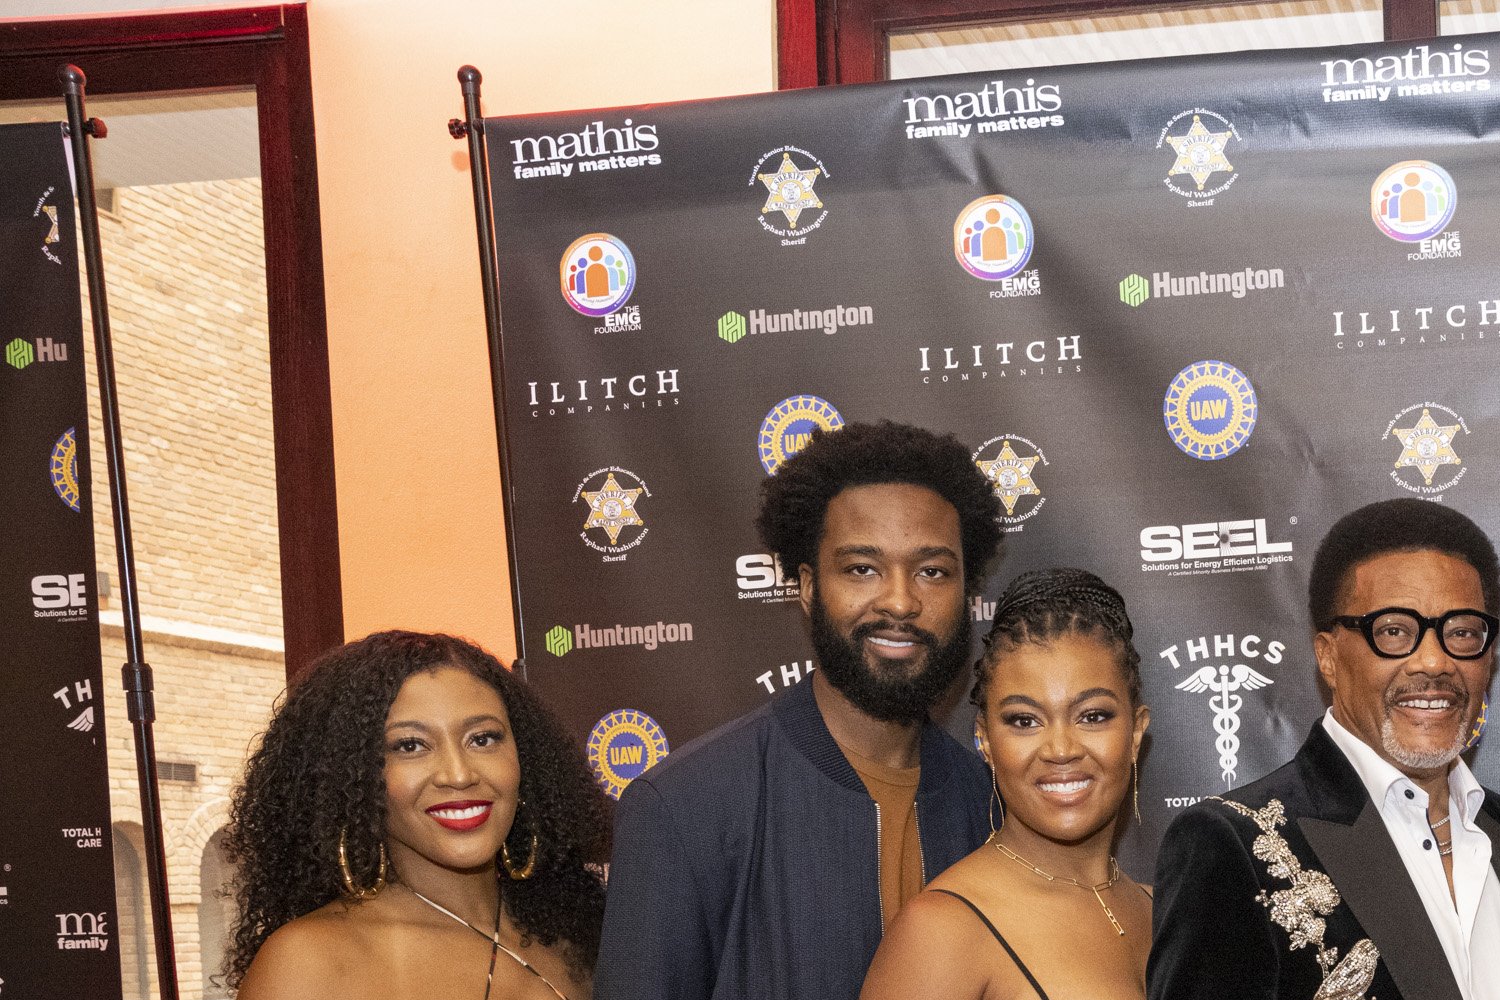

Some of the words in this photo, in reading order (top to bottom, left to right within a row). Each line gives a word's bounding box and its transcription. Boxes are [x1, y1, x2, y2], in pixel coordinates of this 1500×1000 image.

[1320, 44, 1490, 88] mathis
[1322, 83, 1392, 103] family
[1397, 78, 1490, 98] matters
[903, 79, 1062, 124] mathis
[906, 118, 972, 139] family
[978, 113, 1064, 134] matters
[510, 118, 659, 165] mathis
[513, 162, 573, 179] family
[579, 154, 661, 173] matters
[749, 164, 760, 186] Youth
[763, 146, 783, 159] Senior
[784, 146, 817, 161] Education
[817, 160, 830, 178] Fund
[1164, 178, 1192, 197] Raphael
[1194, 173, 1239, 198] Washington
[1187, 199, 1214, 207] Sheriff
[758, 215, 785, 236] Raphael
[787, 210, 828, 236] Washington
[781, 237, 806, 246] Sheriff
[1443, 231, 1459, 240] THE
[1407, 249, 1461, 261] FOUNDATION
[1420, 239, 1461, 254] EMG
[1001, 277, 1040, 291] EMG
[1023, 269, 1039, 278] THE
[1153, 267, 1284, 298] Huntington
[989, 288, 1041, 299] FOUNDATION
[605, 312, 641, 327] EMG
[625, 305, 640, 313] THE
[594, 324, 642, 334] FOUNDATION
[749, 305, 873, 335] Huntington
[919, 335, 1081, 371] ILITCH
[923, 364, 1081, 384] COMPANIES
[528, 369, 680, 405] ILITCH
[532, 398, 679, 417] COMPANIES
[1190, 399, 1227, 421] UAW
[572, 483, 584, 503] Youth
[589, 467, 609, 478] Senior
[610, 466, 640, 482] Education
[640, 480, 652, 497] Fund
[1390, 470, 1420, 493] Raphael
[1422, 467, 1467, 493] Washington
[580, 531, 606, 553] Raphael
[607, 528, 649, 553] Washington
[1140, 518, 1293, 562] SEEL
[603, 554, 627, 562] Sheriff
[1141, 561, 1179, 572] Solutions
[1181, 560, 1192, 570] for
[1194, 559, 1221, 571] Energy
[1223, 556, 1255, 567] Efficient
[1257, 554, 1293, 566] Logistics
[738, 590, 772, 600] Solutions
[774, 588, 784, 597] for
[34, 608, 67, 618] Solutions
[68, 608, 78, 616] for
[574, 621, 693, 651] Huntington
[1159, 634, 1286, 670] THHCS
[610, 745, 643, 766] UAW
[62, 828, 93, 837] TOTAL
[77, 838, 101, 847] CARE
[57, 937, 108, 951] family
